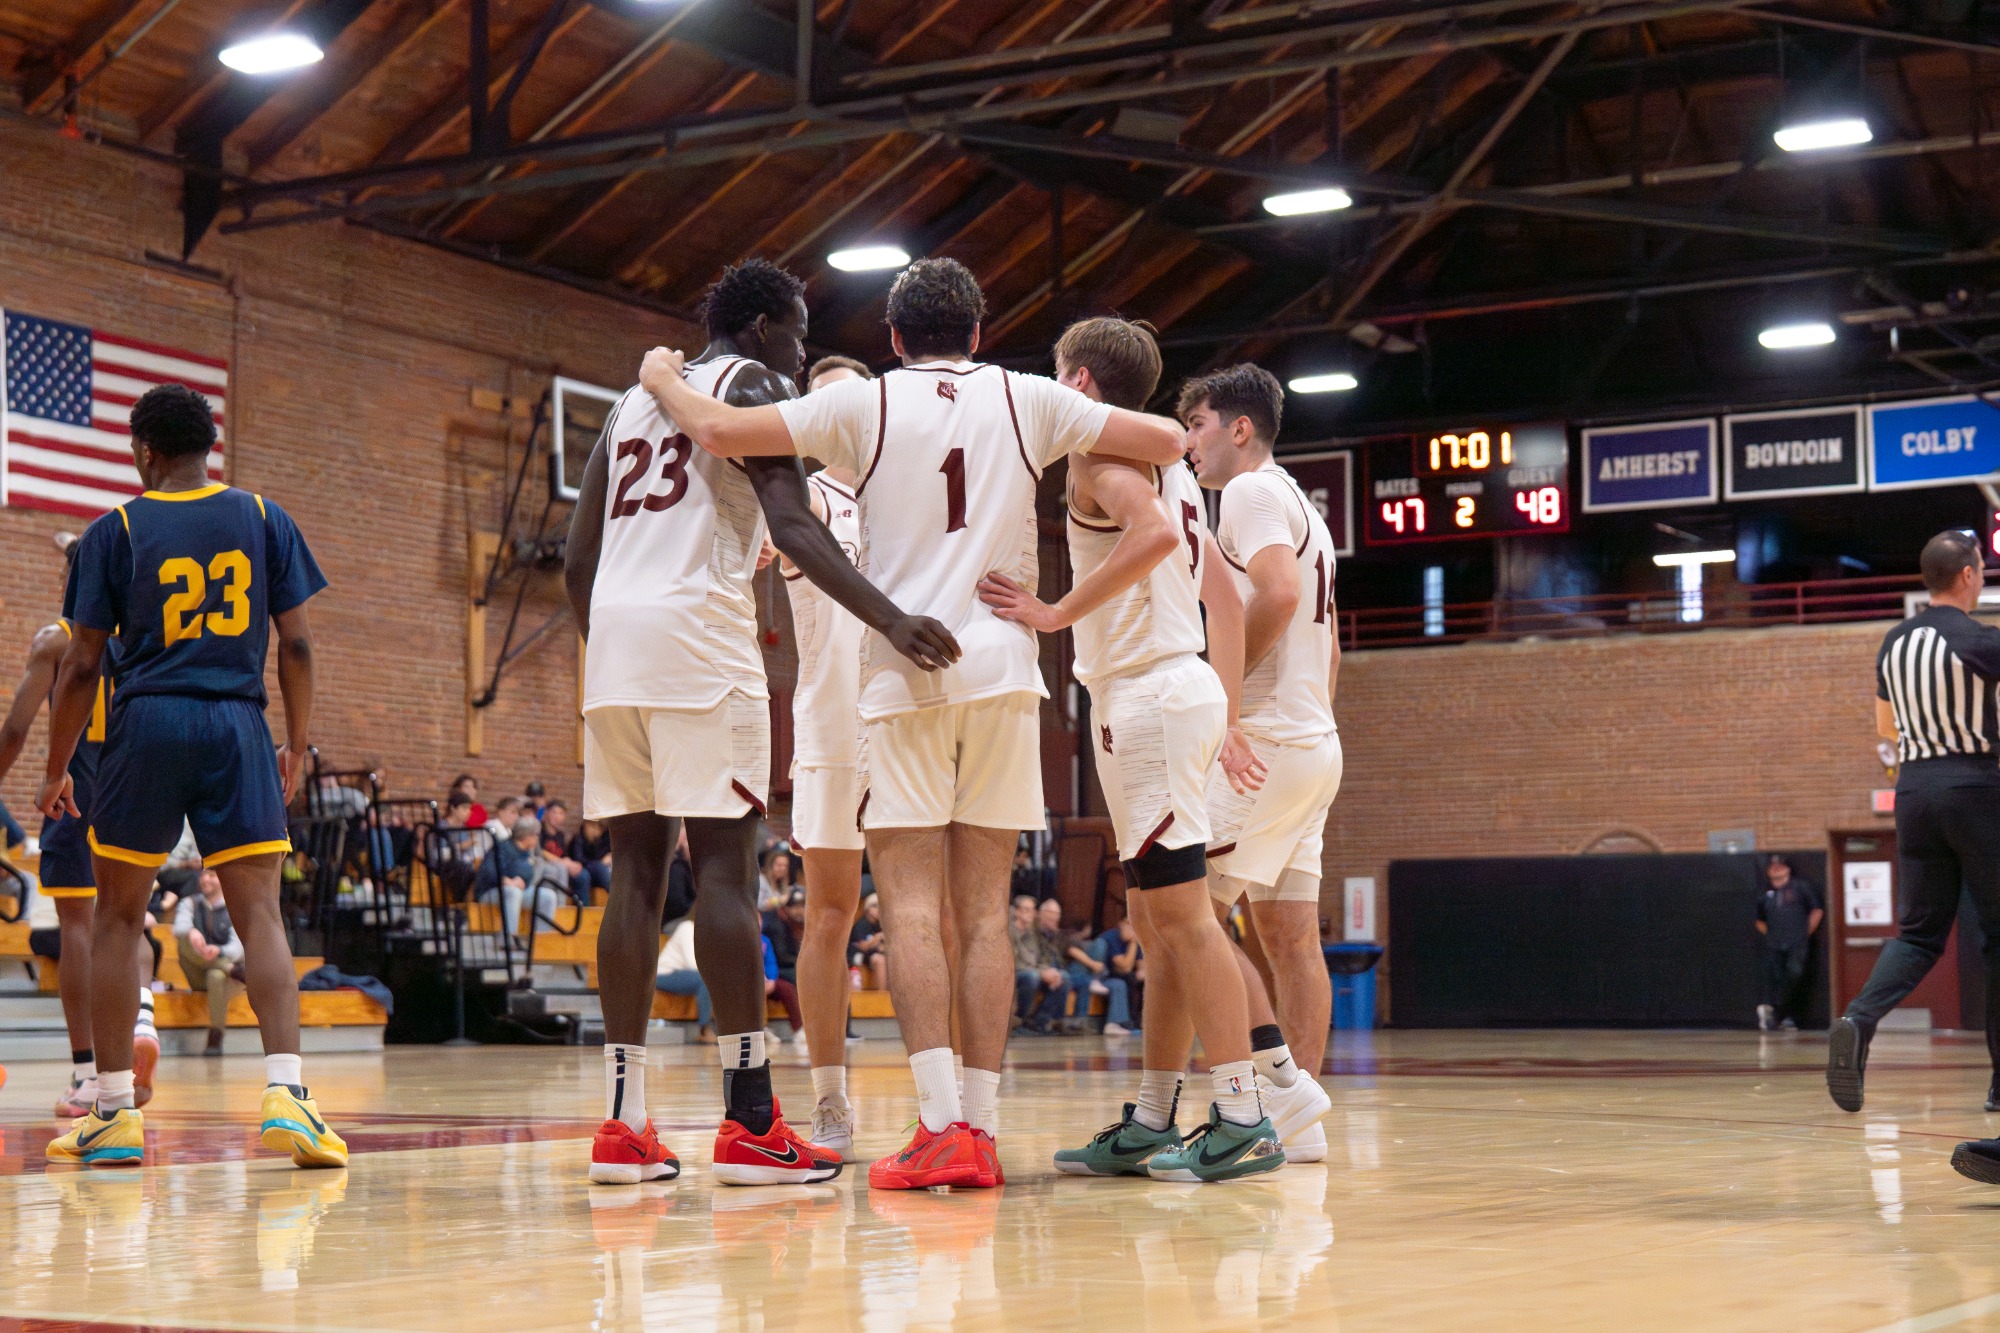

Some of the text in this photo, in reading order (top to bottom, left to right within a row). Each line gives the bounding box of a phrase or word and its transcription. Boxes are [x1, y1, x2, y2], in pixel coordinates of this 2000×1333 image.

[1430, 431, 1512, 470] 17:01
[1745, 437, 1843, 469] BOWDOIN
[1901, 426, 1977, 457] COLBY
[610, 432, 693, 520] 23
[1599, 450, 1699, 482] AMHERST
[938, 447, 968, 534] 1
[1375, 478, 1420, 499] BATES
[1516, 486, 1561, 524] 48
[1382, 498, 1425, 533] 47
[1455, 497, 1476, 528] 2
[1180, 499, 1200, 580] 5
[158, 549, 252, 649] 23
